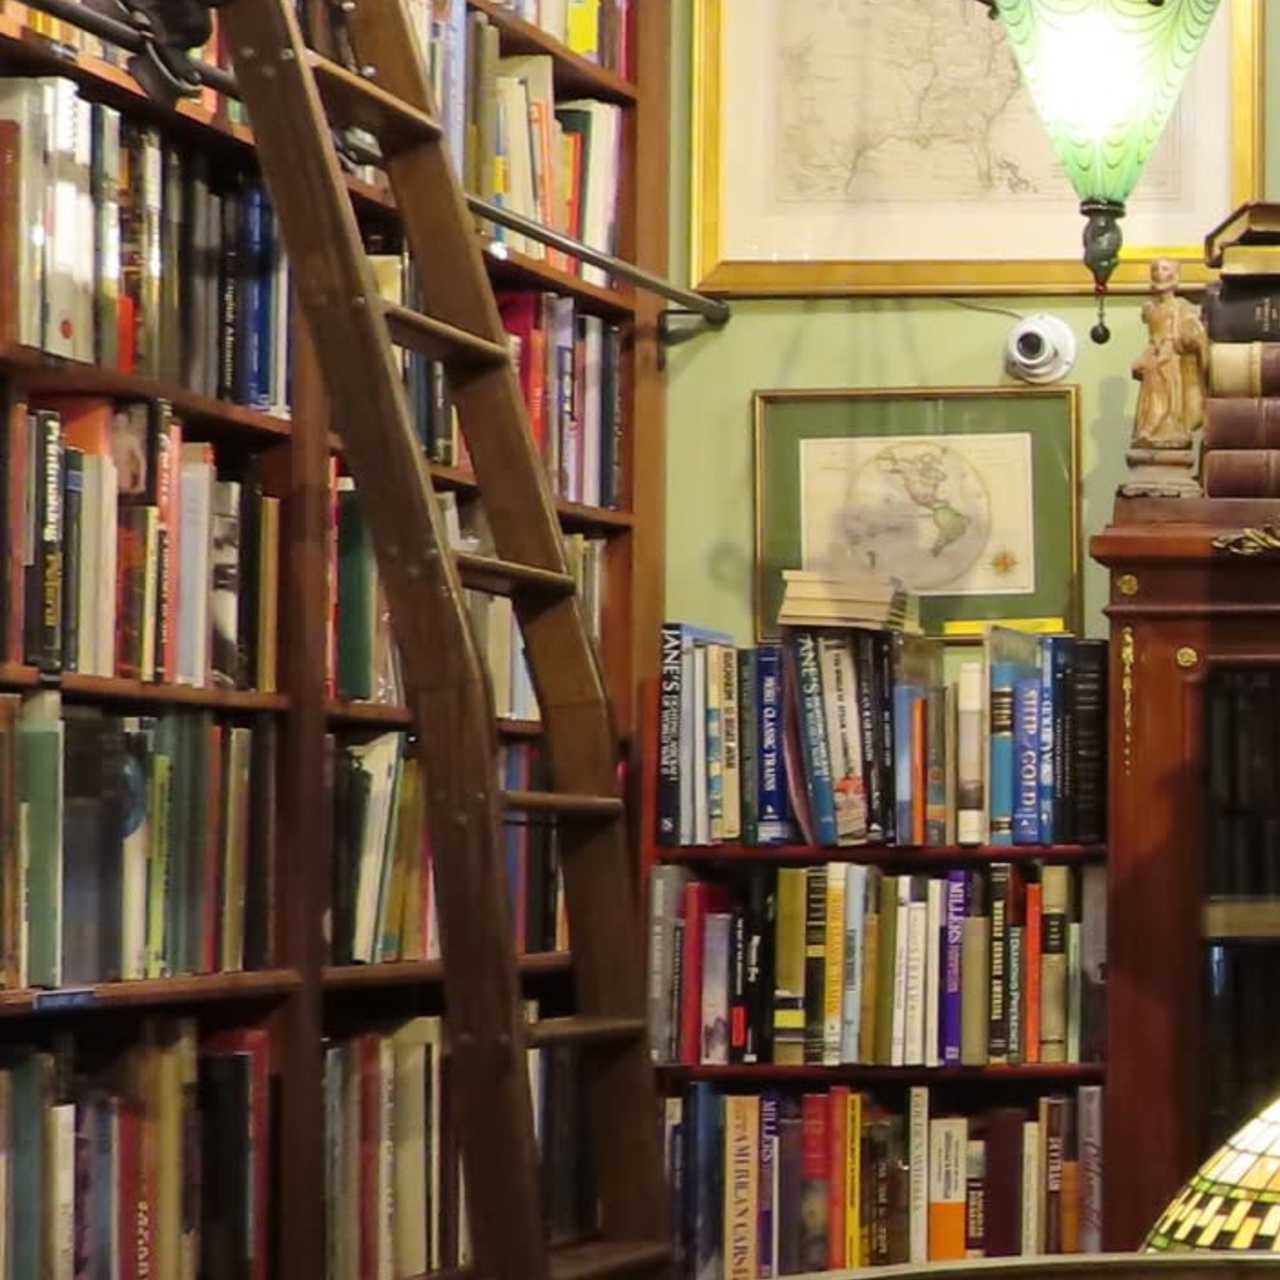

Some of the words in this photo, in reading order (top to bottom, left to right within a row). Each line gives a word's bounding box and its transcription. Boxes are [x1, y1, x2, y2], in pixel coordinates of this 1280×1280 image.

[661, 628, 680, 694] JANE'S
[763, 707, 776, 749] CLASSIC
[1022, 689, 1037, 735] SHIP
[763, 752, 776, 791] TRAINS
[1021, 750, 1037, 806] GOLD
[733, 1131, 750, 1222] AMERICAN
[732, 1223, 749, 1265] CARS
